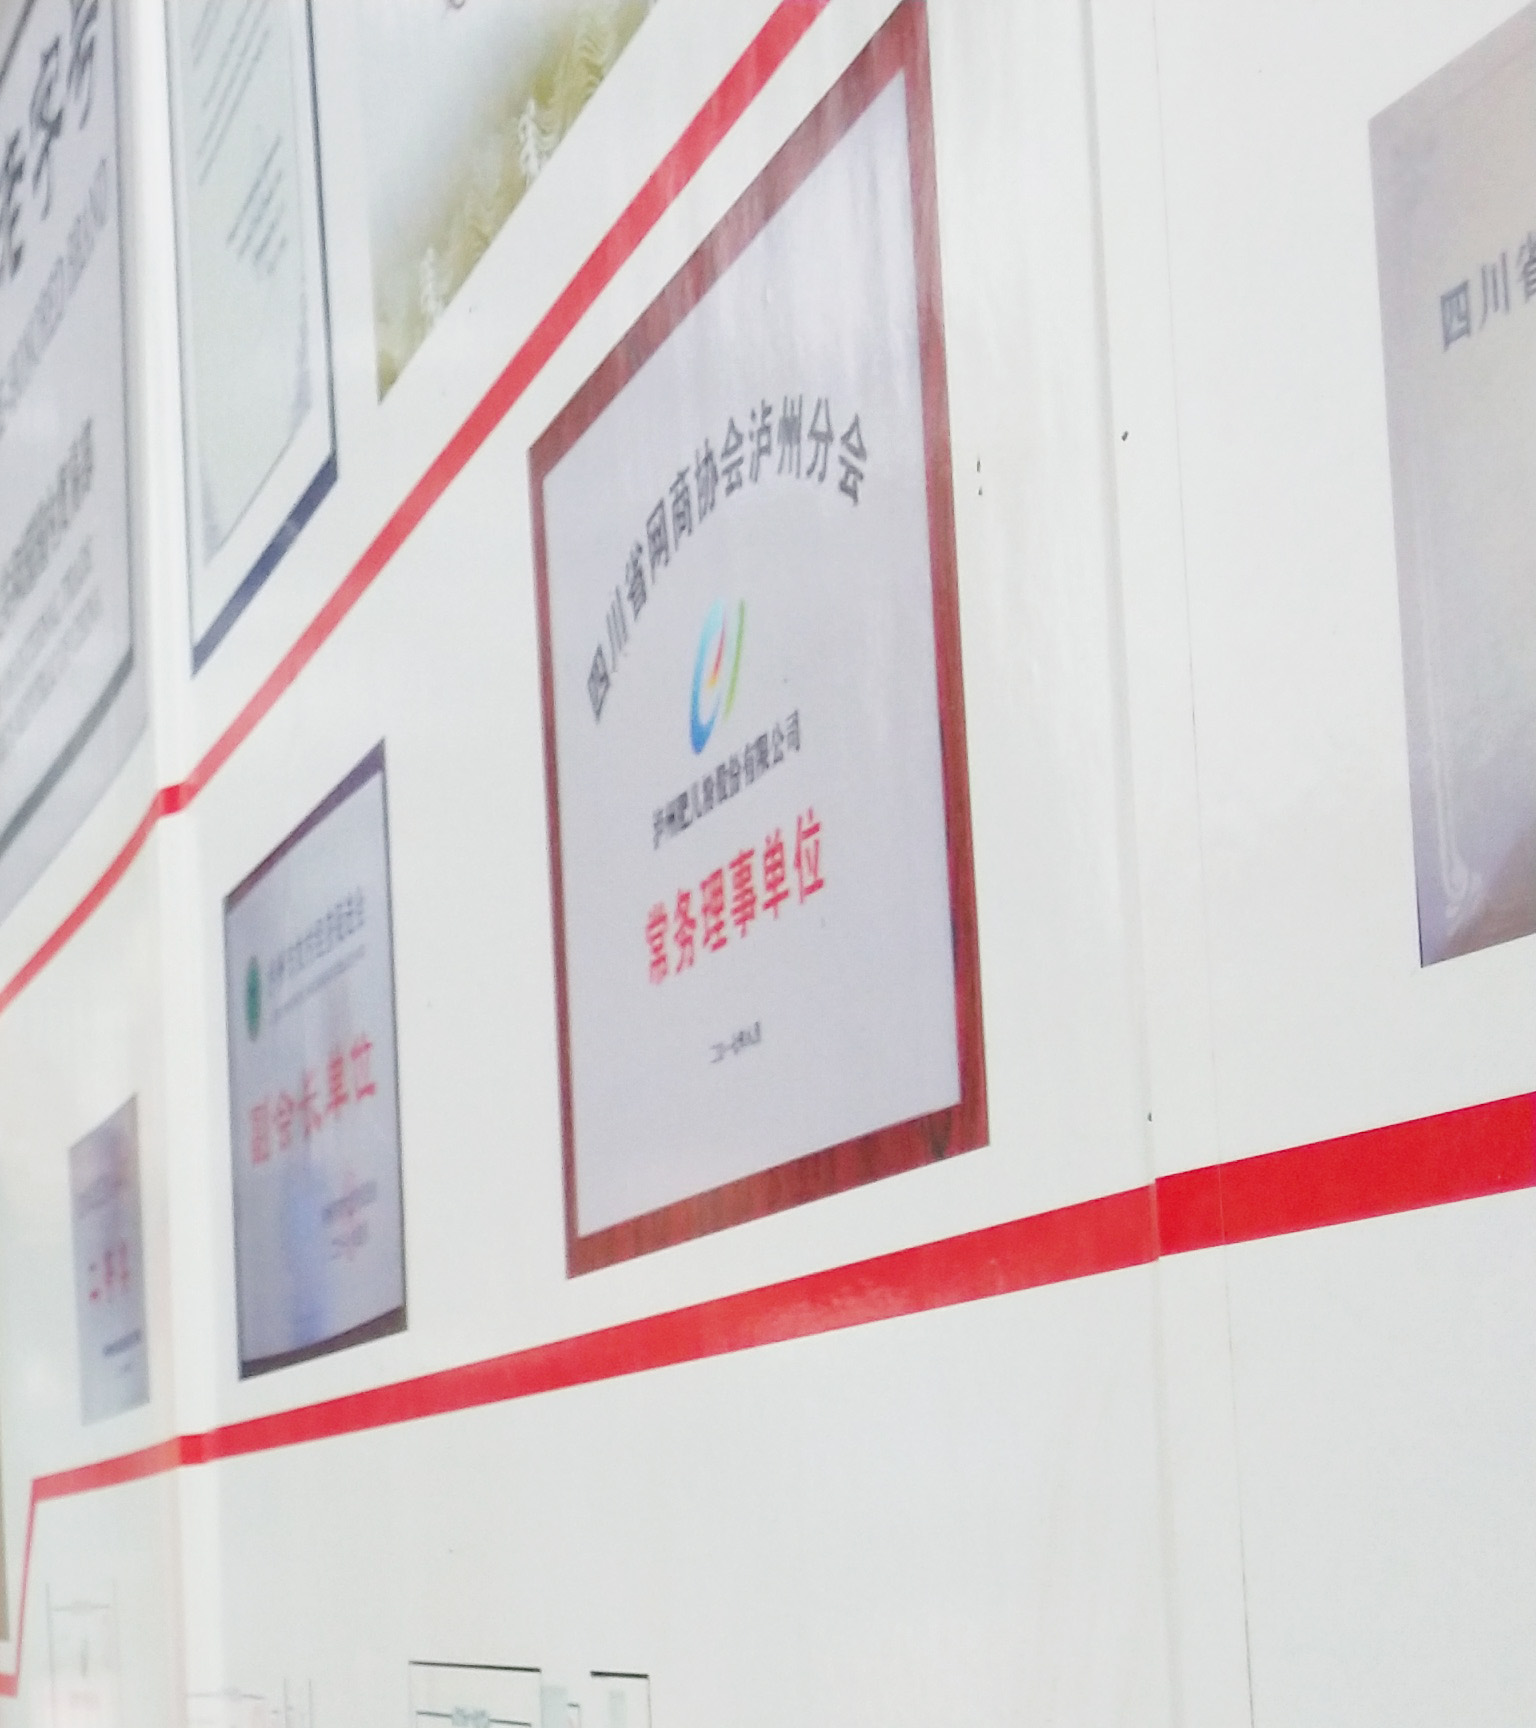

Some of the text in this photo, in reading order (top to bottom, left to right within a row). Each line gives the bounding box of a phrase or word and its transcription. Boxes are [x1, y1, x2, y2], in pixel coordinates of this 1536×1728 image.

[586, 394, 866, 725] 四川省网商协会泸州分会
[645, 805, 825, 984] 常务理事单位
